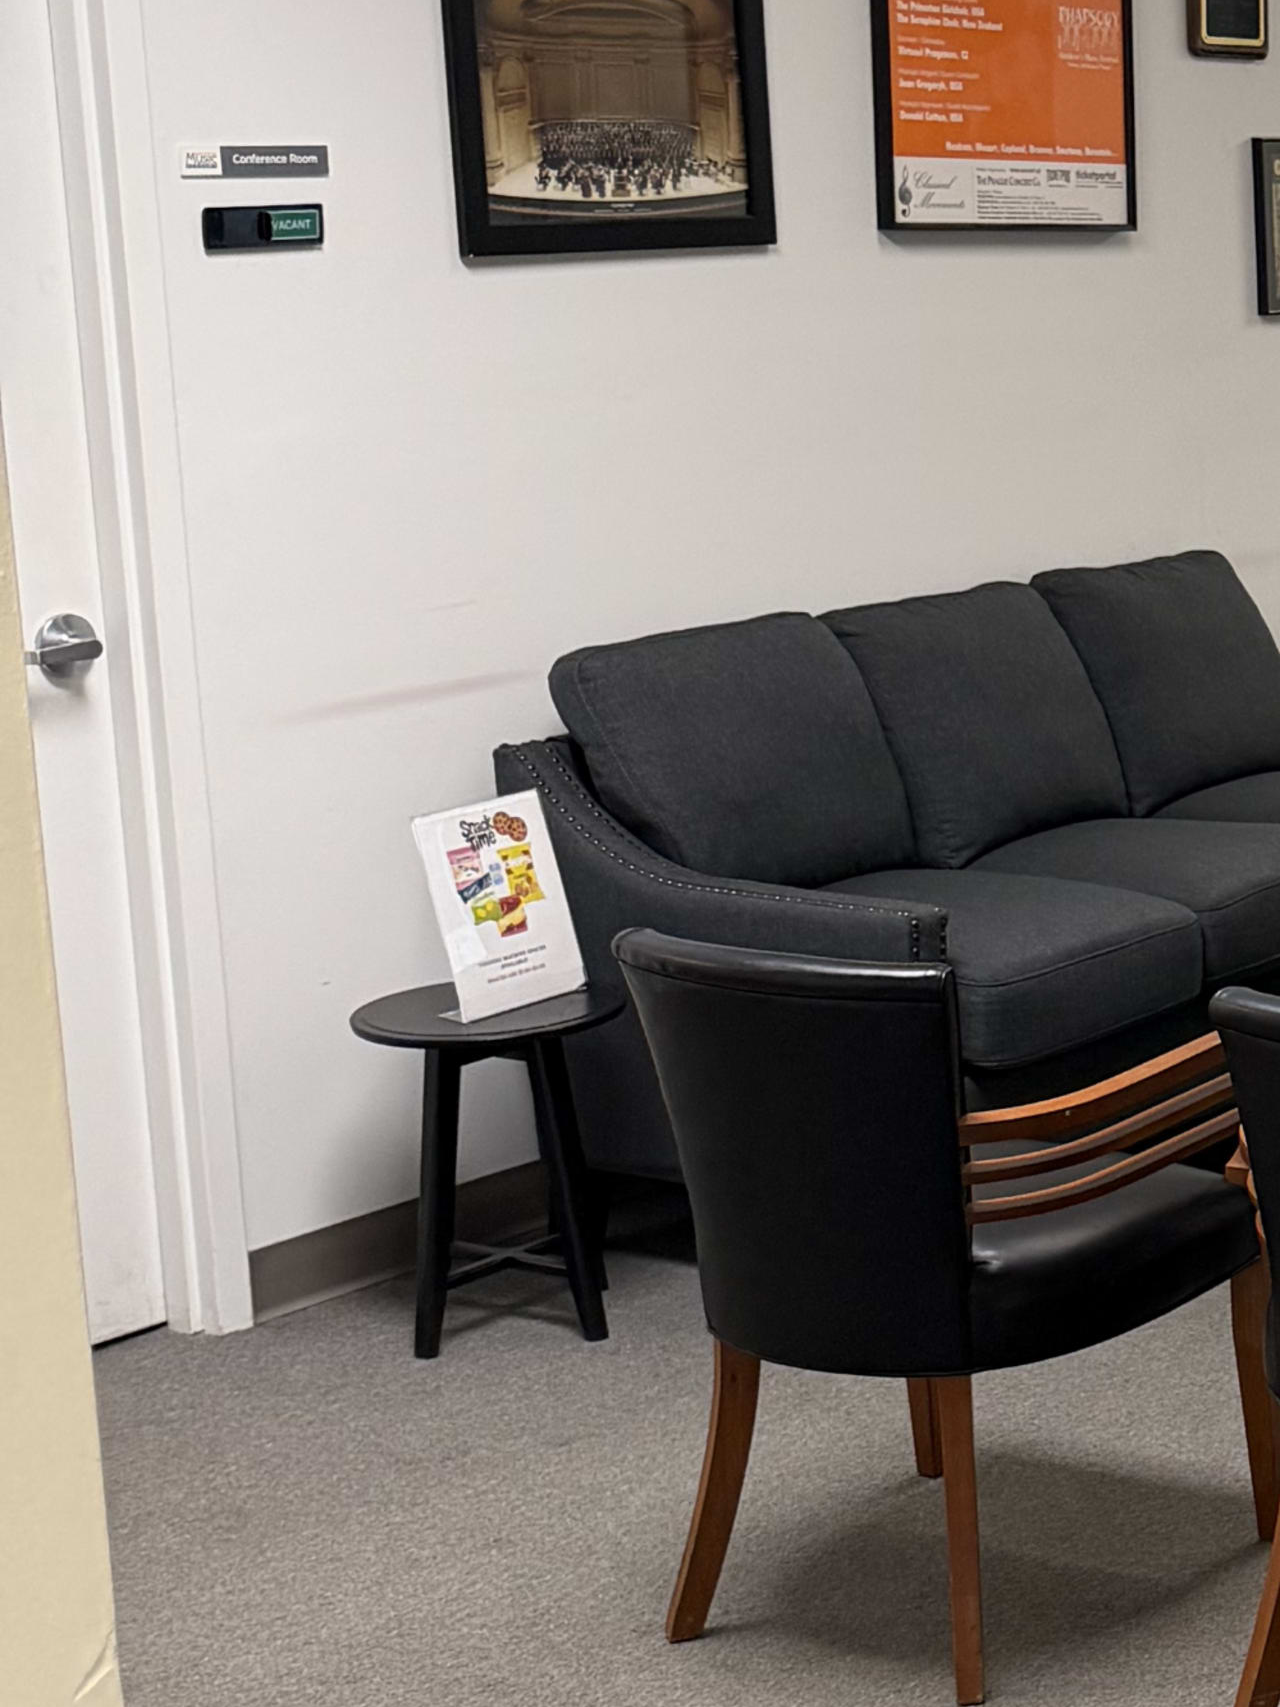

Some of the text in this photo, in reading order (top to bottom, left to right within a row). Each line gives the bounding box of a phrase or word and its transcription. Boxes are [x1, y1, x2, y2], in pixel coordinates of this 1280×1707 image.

[232, 153, 318, 164] Conference Room
[271, 218, 312, 231] VACANT
[459, 813, 494, 838] Snack
[465, 829, 497, 852] Time
